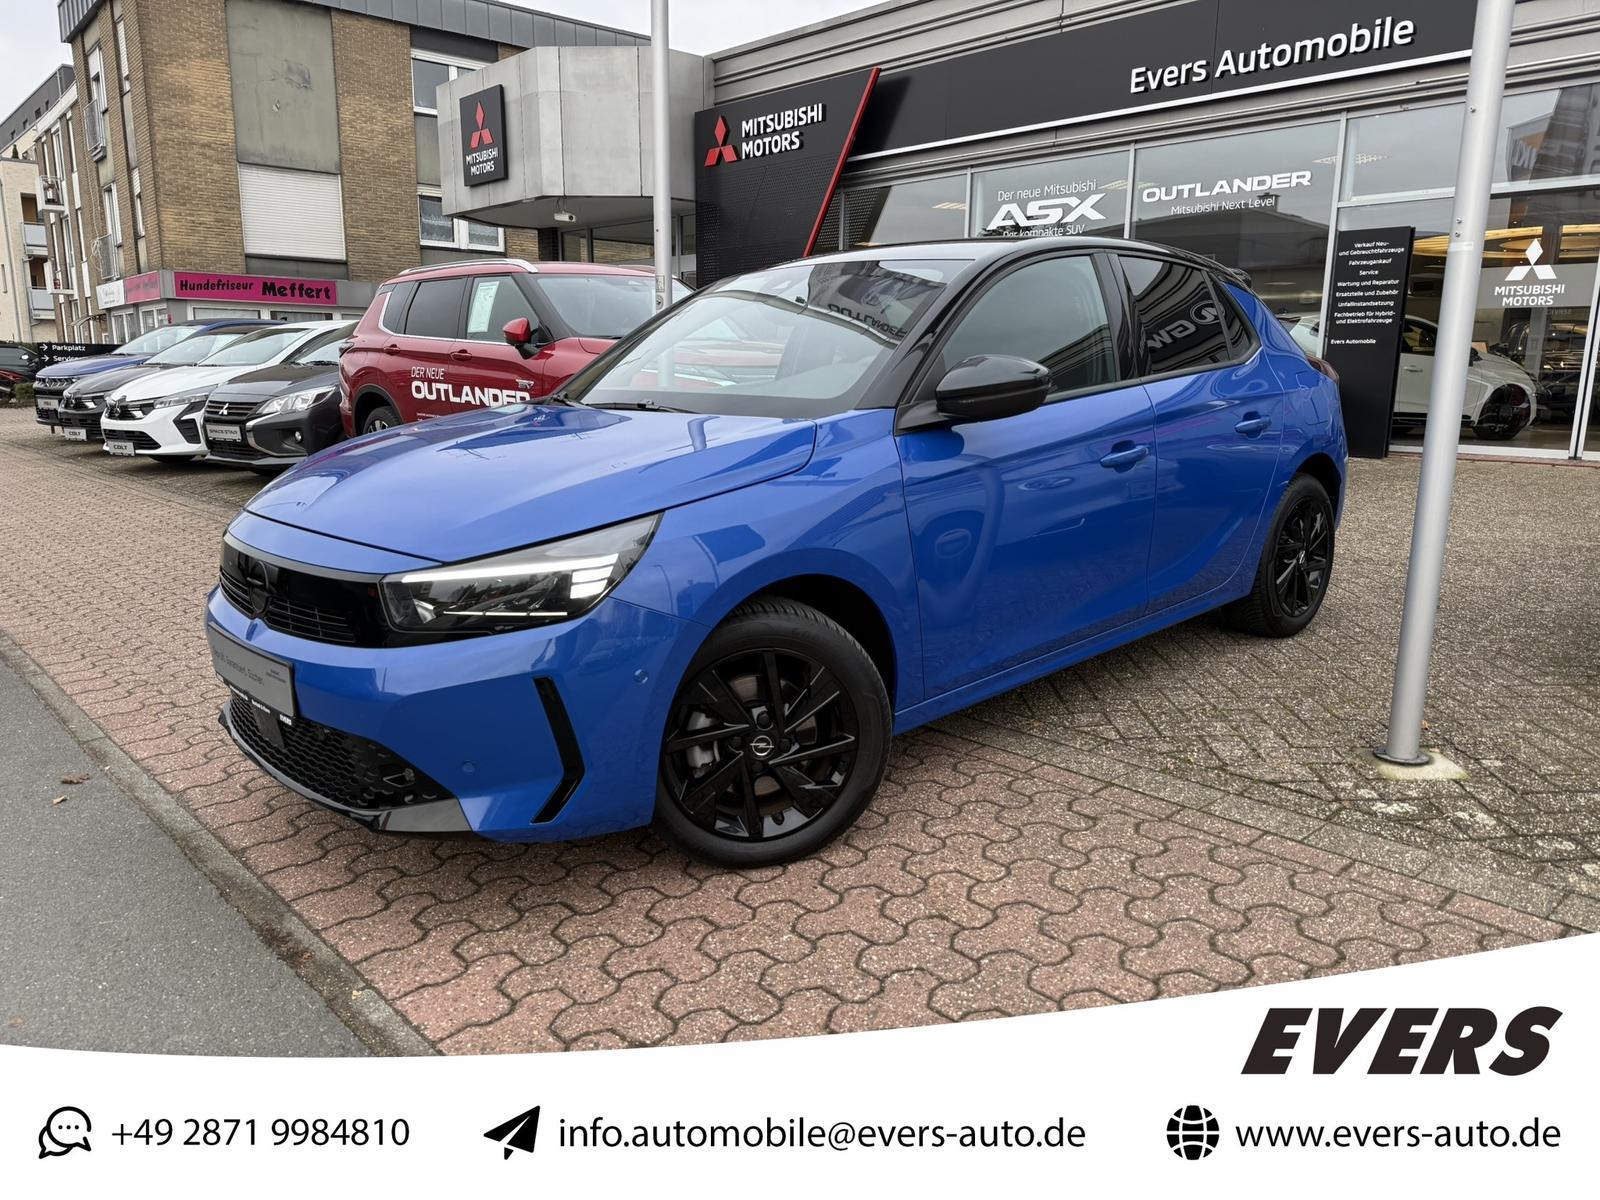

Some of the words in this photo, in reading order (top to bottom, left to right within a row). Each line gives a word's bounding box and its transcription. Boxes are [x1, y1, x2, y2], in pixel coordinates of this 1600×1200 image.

[1130, 59, 1207, 94] Evers
[1214, 16, 1414, 78] Automobile
[741, 103, 823, 138] MITSUBISHI
[741, 130, 800, 160] MOTORS
[466, 147, 499, 165] MITSUBISHI
[470, 161, 495, 176] MOTORS
[997, 190, 1014, 201] Der
[1016, 188, 1041, 200] neue
[1044, 179, 1097, 197] Mitsubishi
[1142, 170, 1312, 203] OUTLANDER
[986, 193, 1107, 231] ASX
[1171, 202, 1219, 216] Mitsubishi
[1222, 199, 1246, 211] Next
[1249, 196, 1276, 209] Level
[1066, 224, 1085, 236] SUV
[1349, 247, 1405, 256] Gebrauchtfahrzeuge
[1354, 241, 1375, 249] Verkauf
[1348, 258, 1392, 266] Fahrzeugankauf
[179, 279, 254, 292] Hundefriseur
[262, 281, 331, 300] Meffert
[1494, 284, 1566, 296] MITSUBISHI
[1502, 296, 1554, 307] MOTORS
[51, 344, 86, 352] Parkplatz
[411, 366, 425, 378] DER
[426, 368, 445, 380] NEUE
